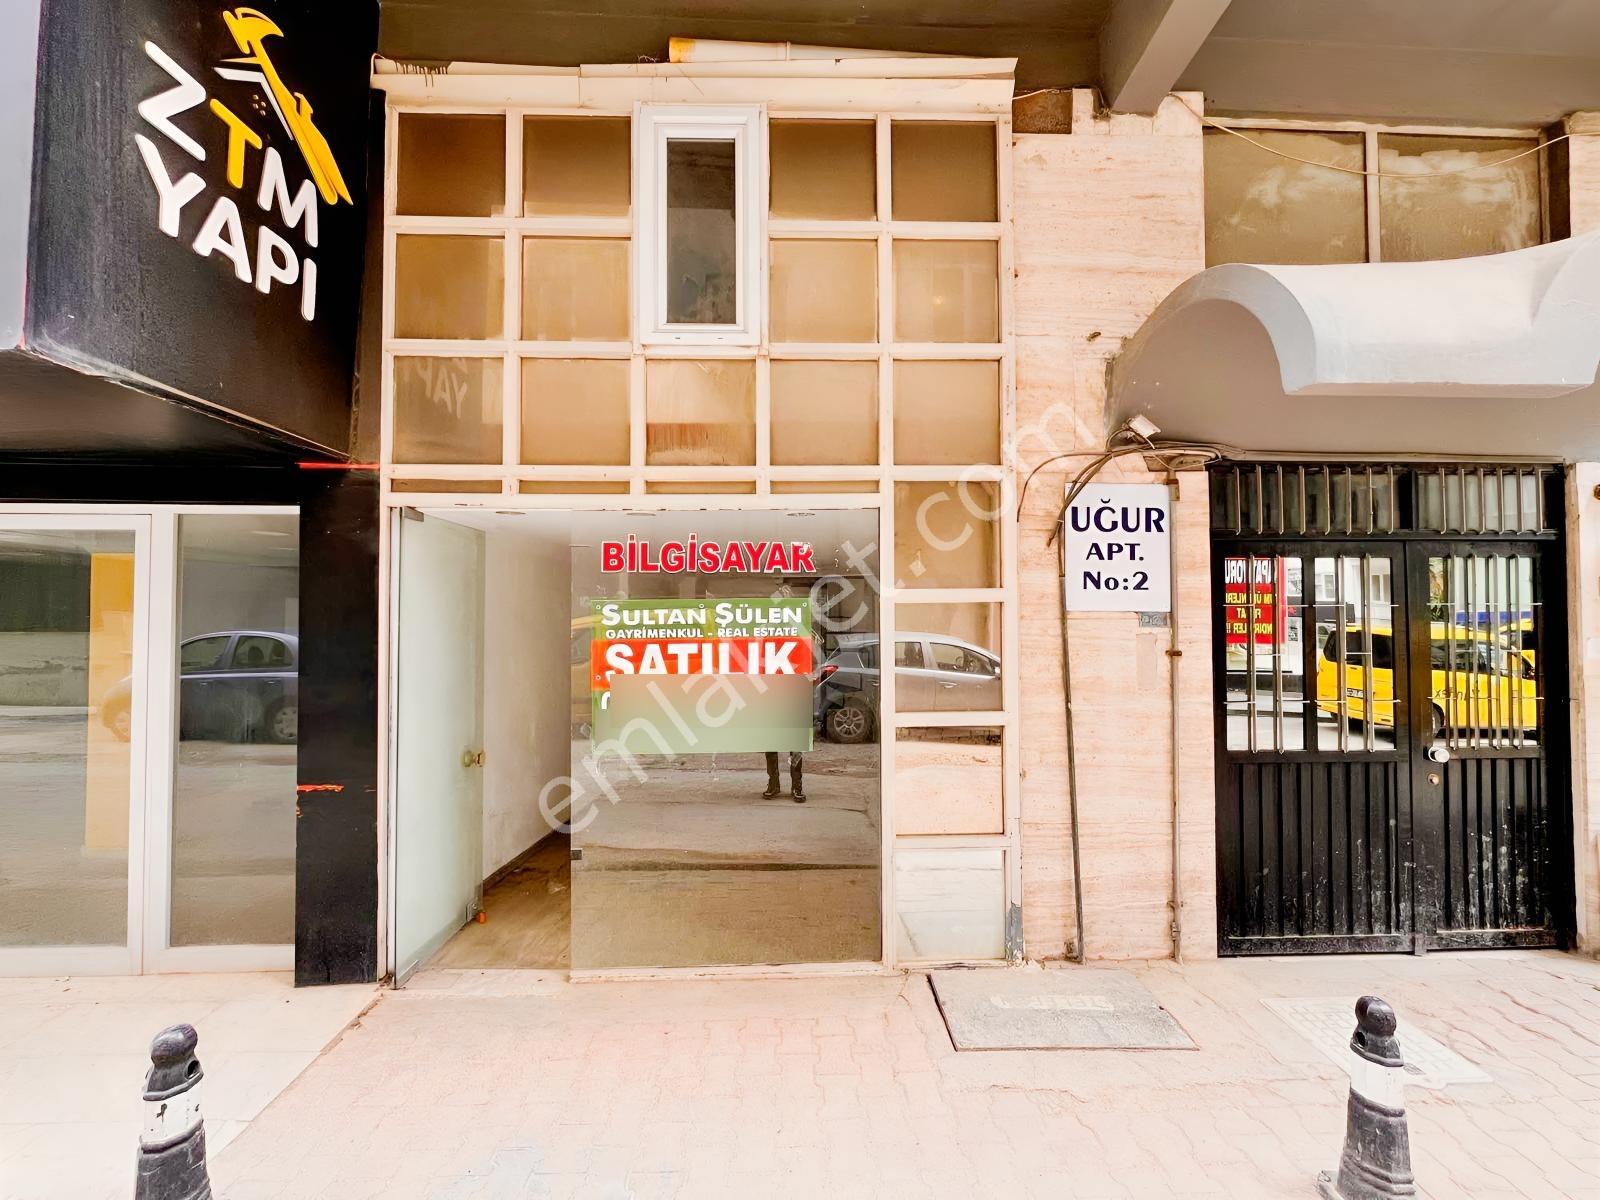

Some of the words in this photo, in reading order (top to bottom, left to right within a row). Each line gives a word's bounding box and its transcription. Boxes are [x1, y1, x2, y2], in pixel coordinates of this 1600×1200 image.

[134, 133, 318, 322] YAPI
[1071, 498, 1165, 533] UĞUR
[601, 533, 816, 574] BİLGİSAYAR
[1086, 542, 1144, 561] APT.
[1083, 571, 1149, 590] No:2
[601, 604, 707, 626] SULTAN
[715, 602, 801, 628] ŞÜLEN
[605, 627, 704, 639] GAYRİMENKUL
[717, 628, 749, 638] REAL
[753, 627, 799, 637] ESTATE
[605, 642, 798, 675] SATILIK
